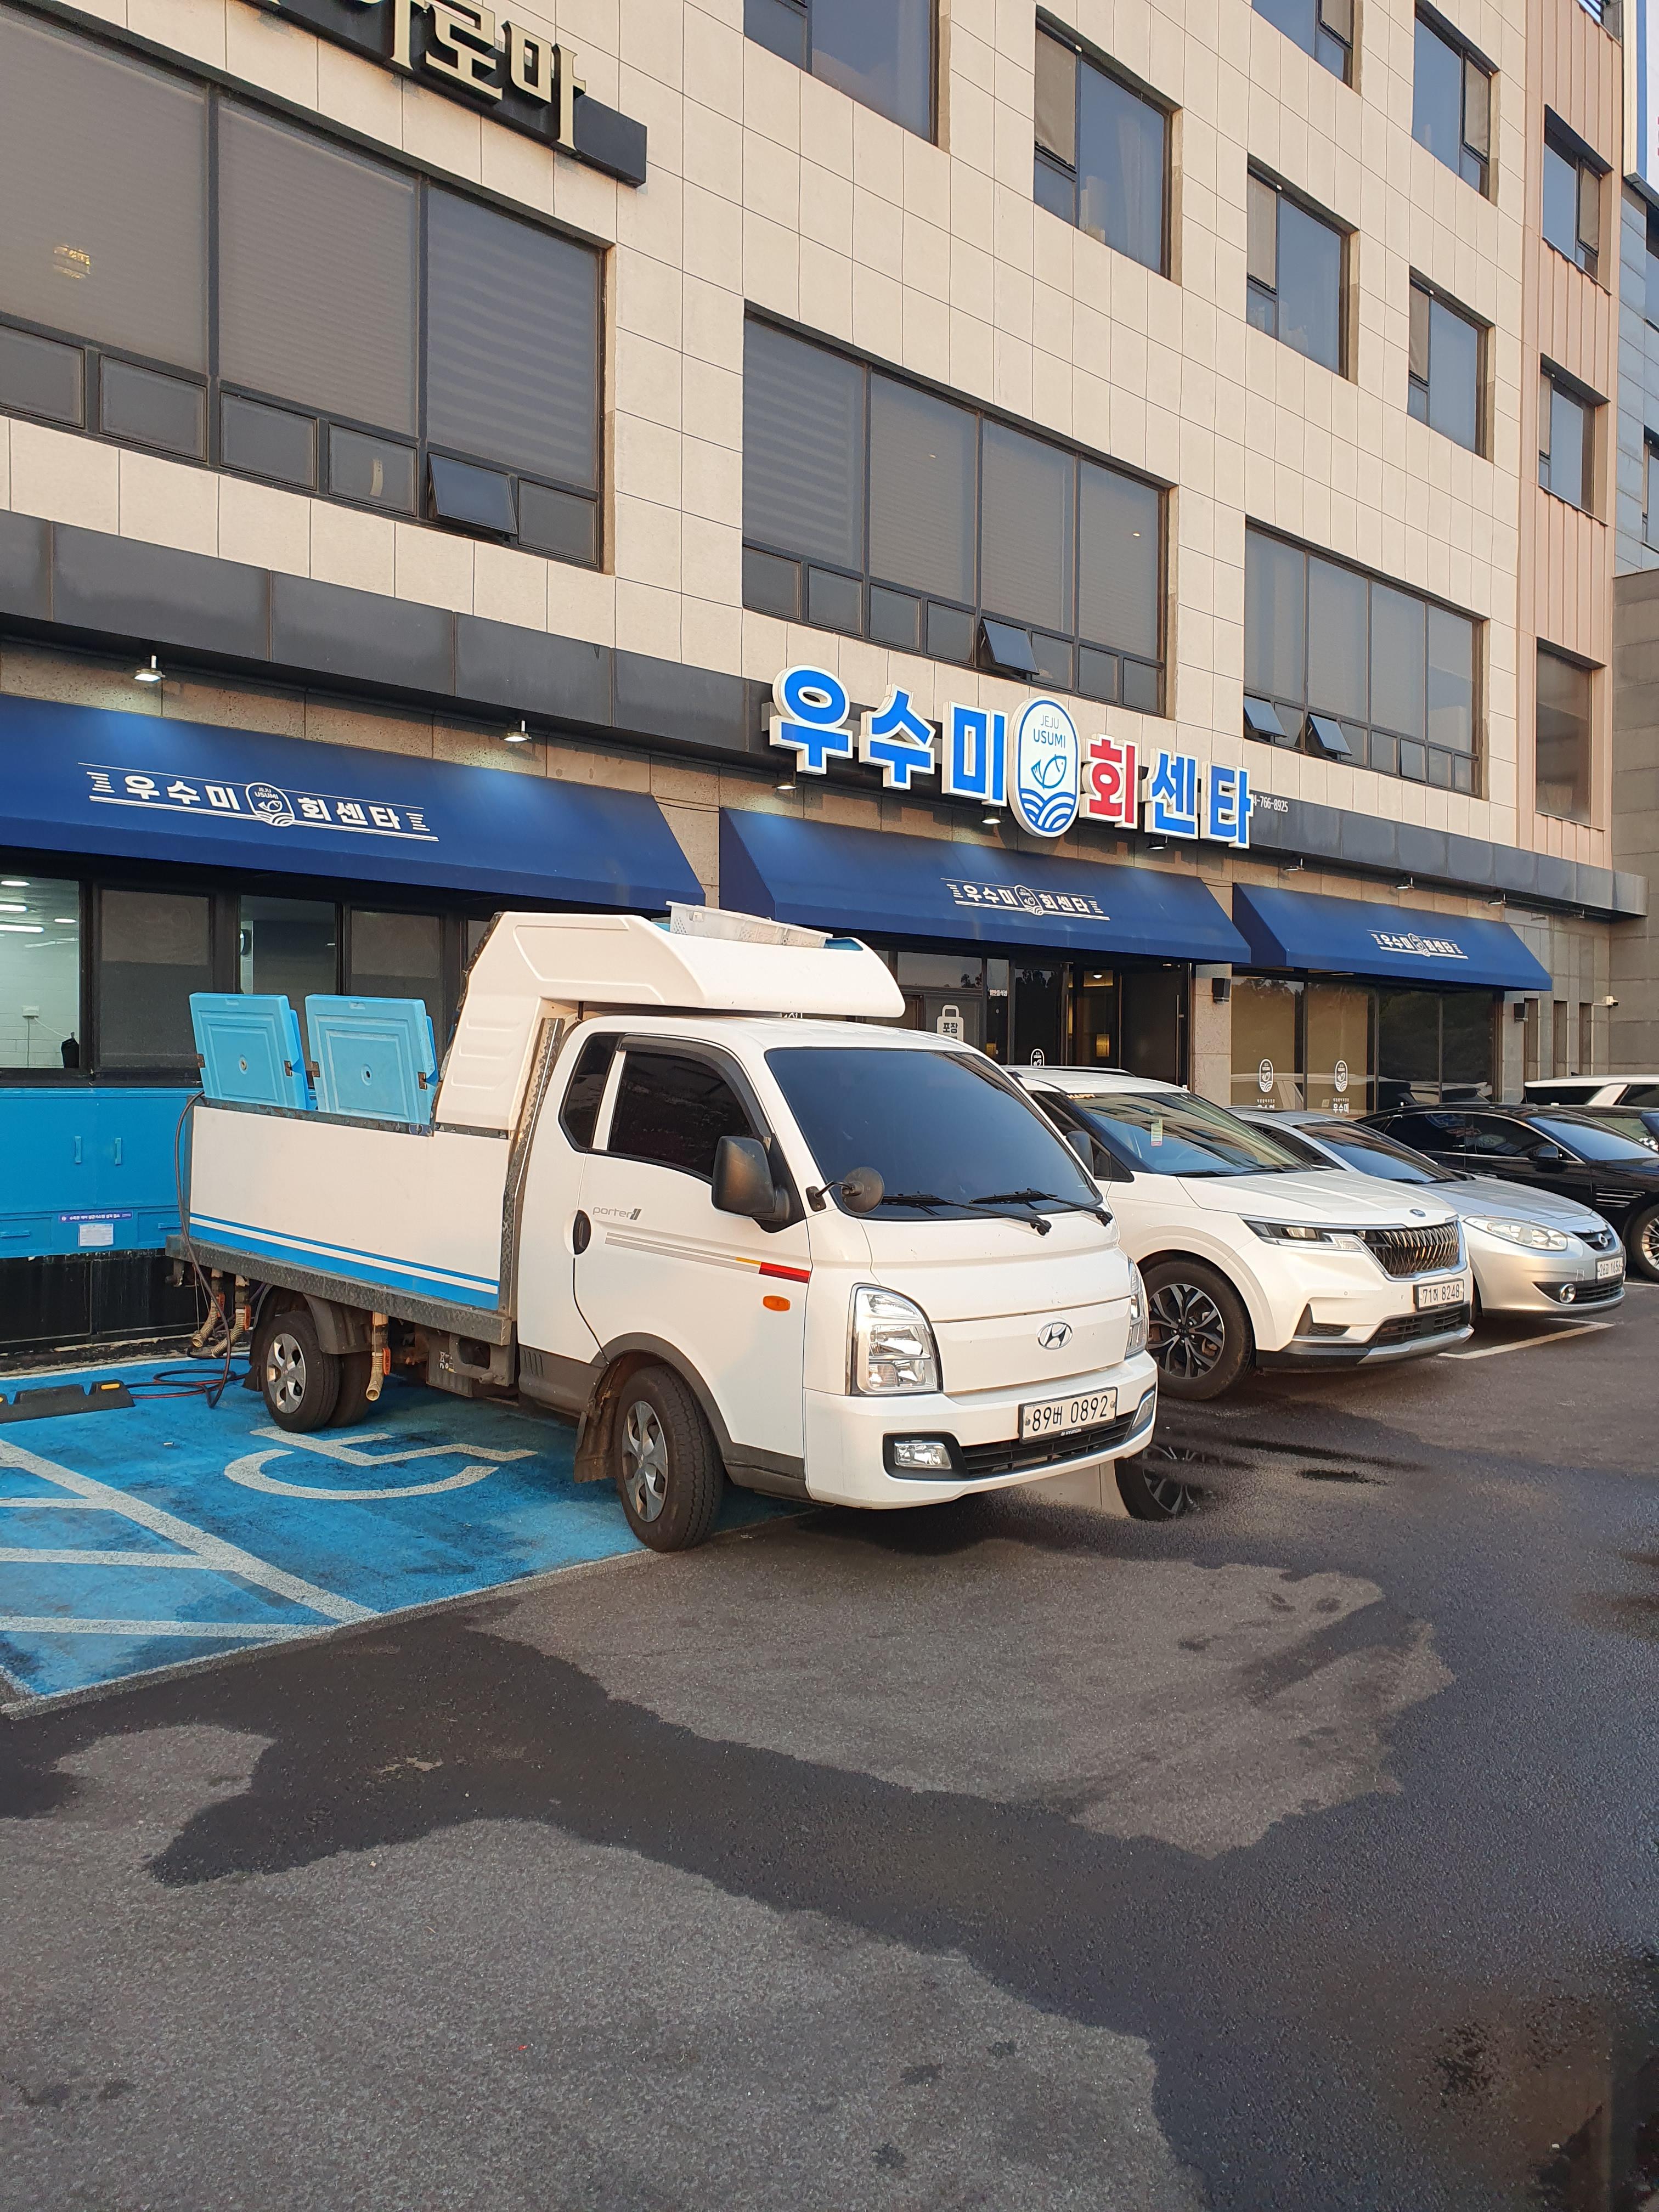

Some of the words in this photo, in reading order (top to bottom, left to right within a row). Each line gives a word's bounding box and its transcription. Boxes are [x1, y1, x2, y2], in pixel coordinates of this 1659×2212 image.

[356, 0, 586, 151] 로마
[1040, 715, 1059, 729] JEJU
[1033, 728, 1066, 749] USUMI
[770, 664, 1008, 807] 우수미
[1079, 733, 1254, 850] 회센타
[124, 775, 241, 810] 우수미
[297, 797, 401, 830] 회센타
[254, 791, 279, 799] USUMI
[1251, 793, 1289, 812] 4-766-8925
[963, 885, 1019, 906] 우수미
[1039, 893, 1091, 913] 회센타
[1380, 934, 1415, 950] 우수미
[943, 1022, 958, 1034] 포장
[1333, 1103, 1349, 1114] 우수미
[1441, 1284, 1460, 1301] 8248
[1032, 1406, 1063, 1432] 89버
[1070, 1395, 1108, 1424] 0892
